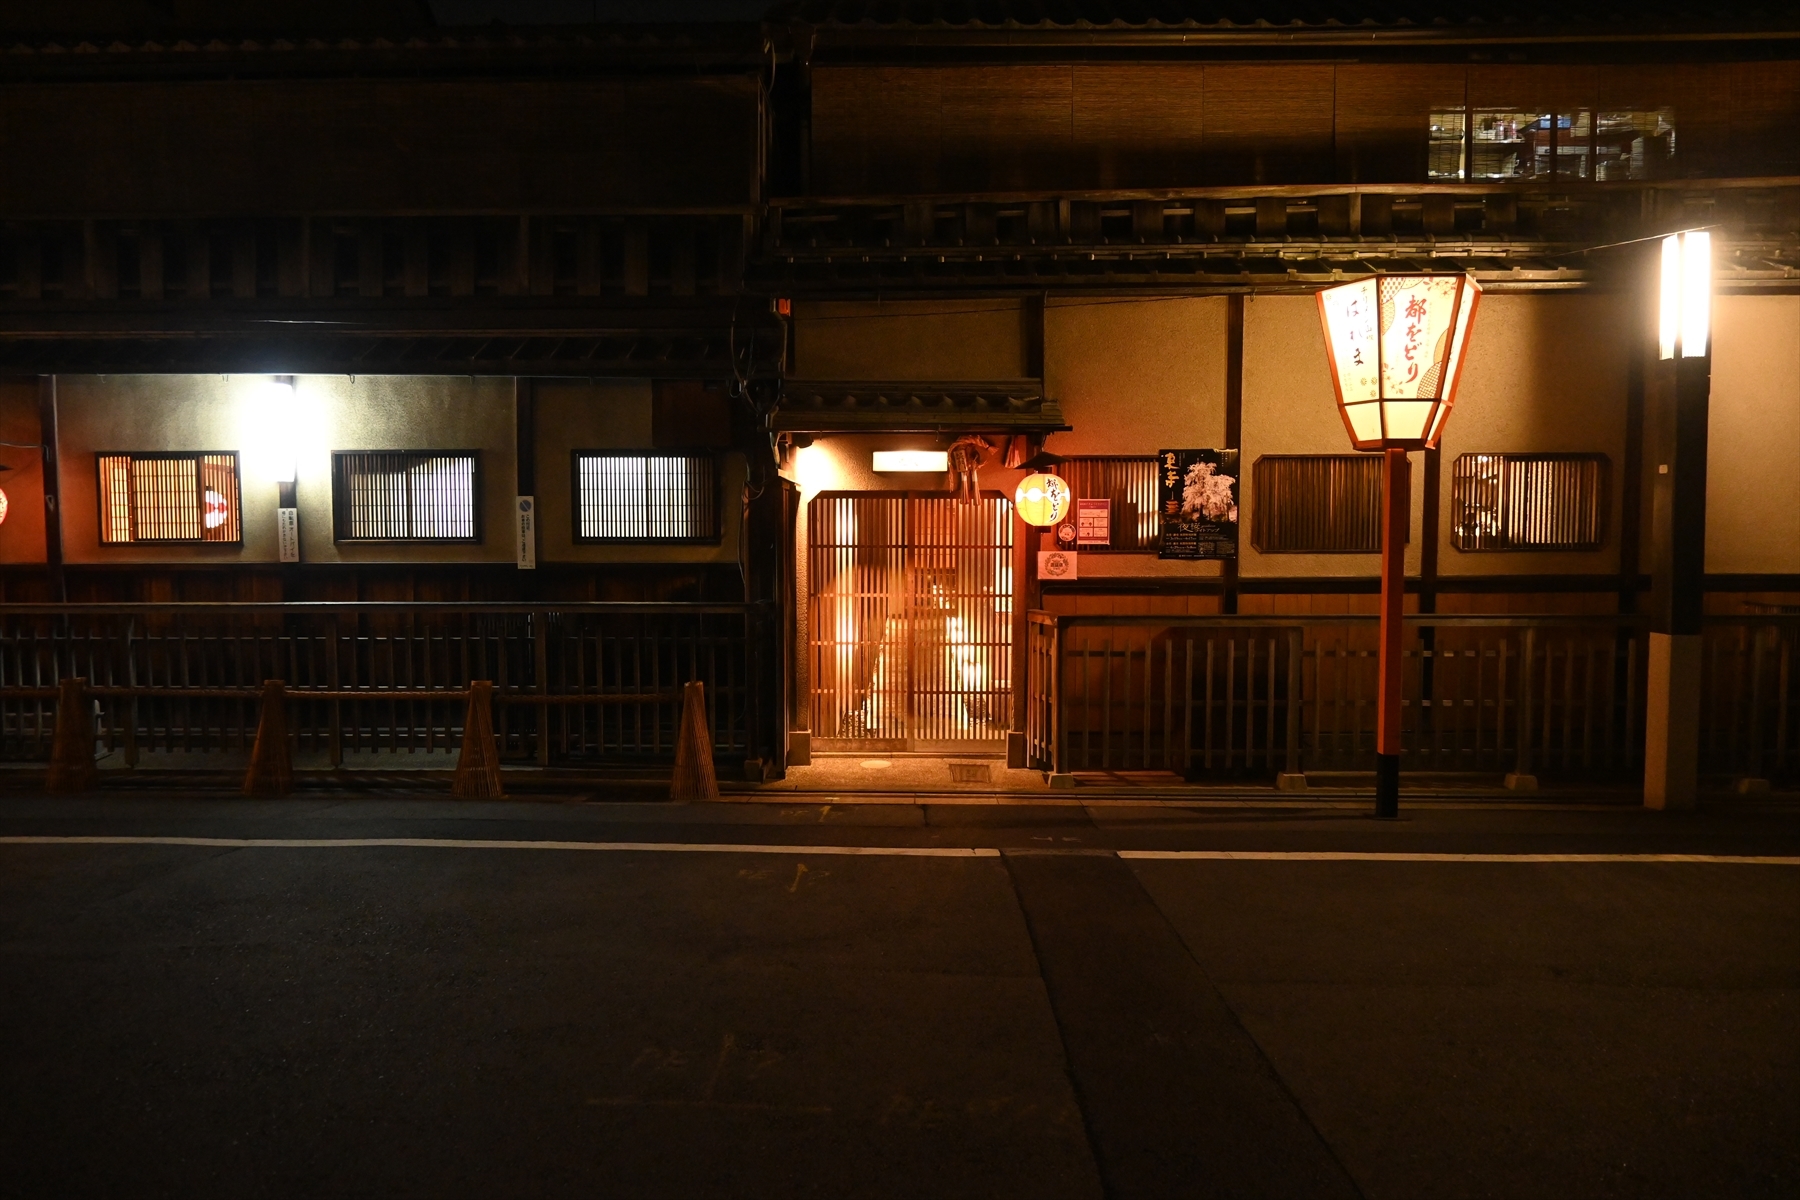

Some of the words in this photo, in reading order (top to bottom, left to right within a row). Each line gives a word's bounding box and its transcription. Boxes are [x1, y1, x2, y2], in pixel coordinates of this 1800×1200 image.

[1405, 295, 1427, 384] 都をどり
[1163, 452, 1181, 489] 東寺
